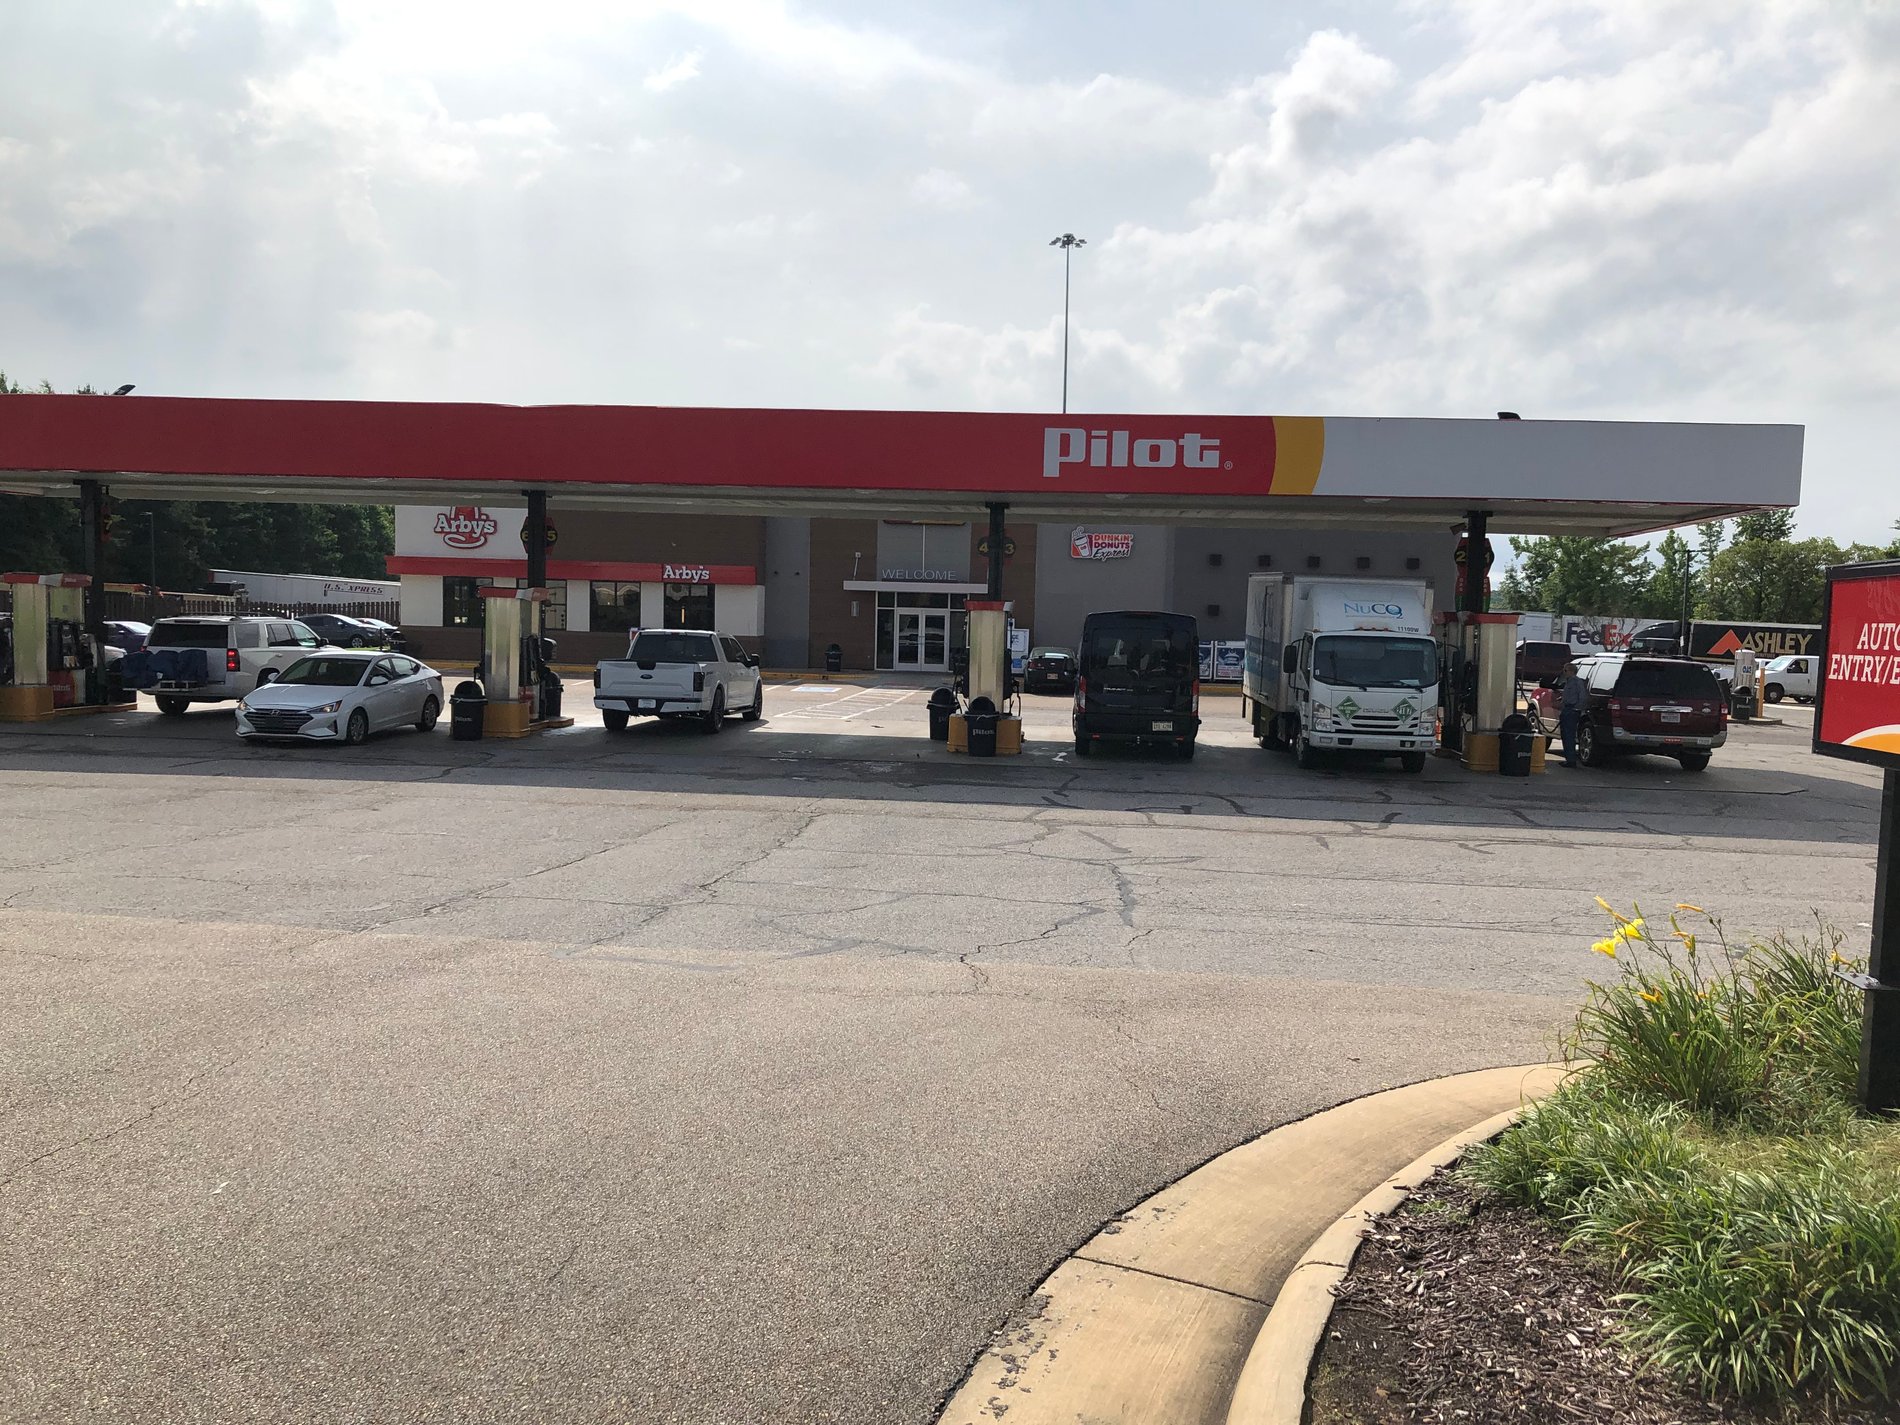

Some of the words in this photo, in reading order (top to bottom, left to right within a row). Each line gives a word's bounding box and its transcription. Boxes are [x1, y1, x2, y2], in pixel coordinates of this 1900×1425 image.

[435, 513, 496, 538] Arby's
[547, 530, 557, 542] 5
[1094, 534, 1133, 542] DUNKIN'
[979, 542, 990, 553] 4
[1004, 543, 1015, 555] 3
[1092, 548, 1130, 559] Express
[1455, 550, 1466, 562] 2
[663, 564, 710, 584] Arby's
[881, 568, 958, 581] WELCOME
[1565, 622, 1634, 647] FedEx
[1741, 632, 1813, 655] ASHLEY
